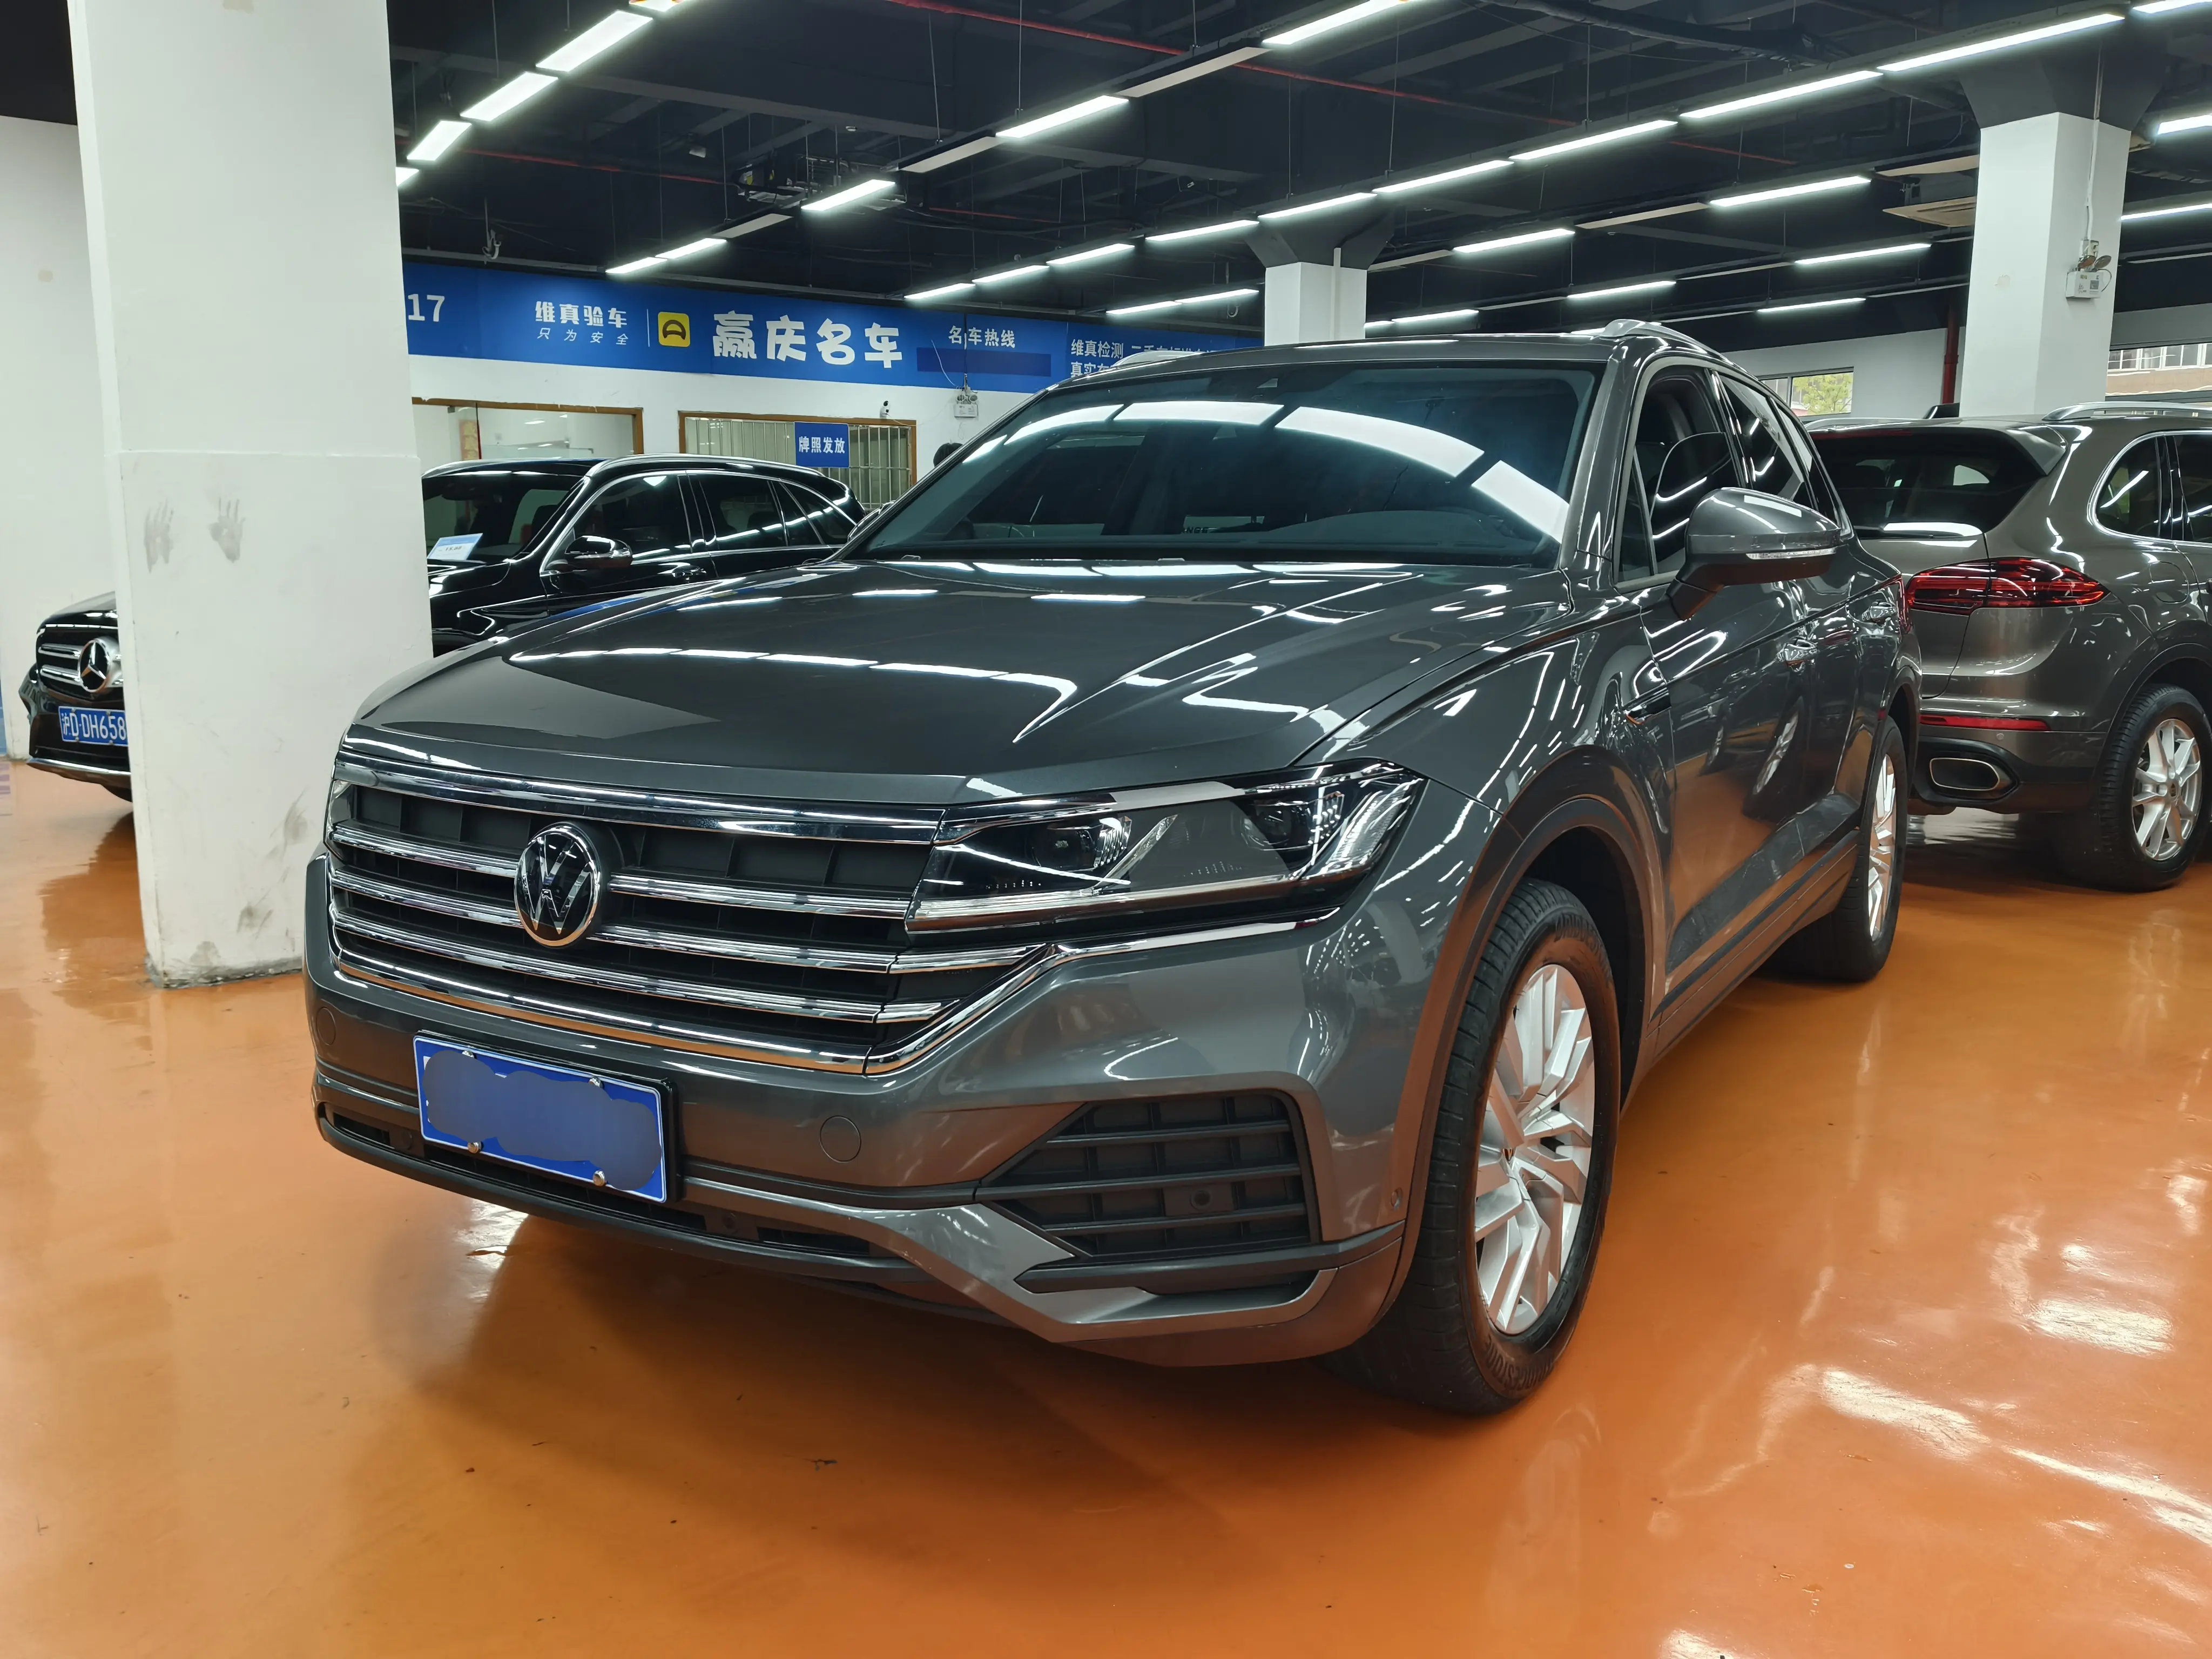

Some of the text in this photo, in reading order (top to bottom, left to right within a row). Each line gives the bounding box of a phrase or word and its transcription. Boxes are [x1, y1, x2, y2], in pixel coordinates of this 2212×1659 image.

[408, 294, 445, 322] 17
[535, 301, 628, 328] 维真验车
[537, 327, 629, 346] 只为安全
[712, 311, 903, 368] 赢庆名车
[948, 326, 1016, 348] 名车热线
[1071, 339, 1124, 359] 维真检测
[1070, 361, 1112, 378] 真实
[799, 436, 846, 454] 牌照发放
